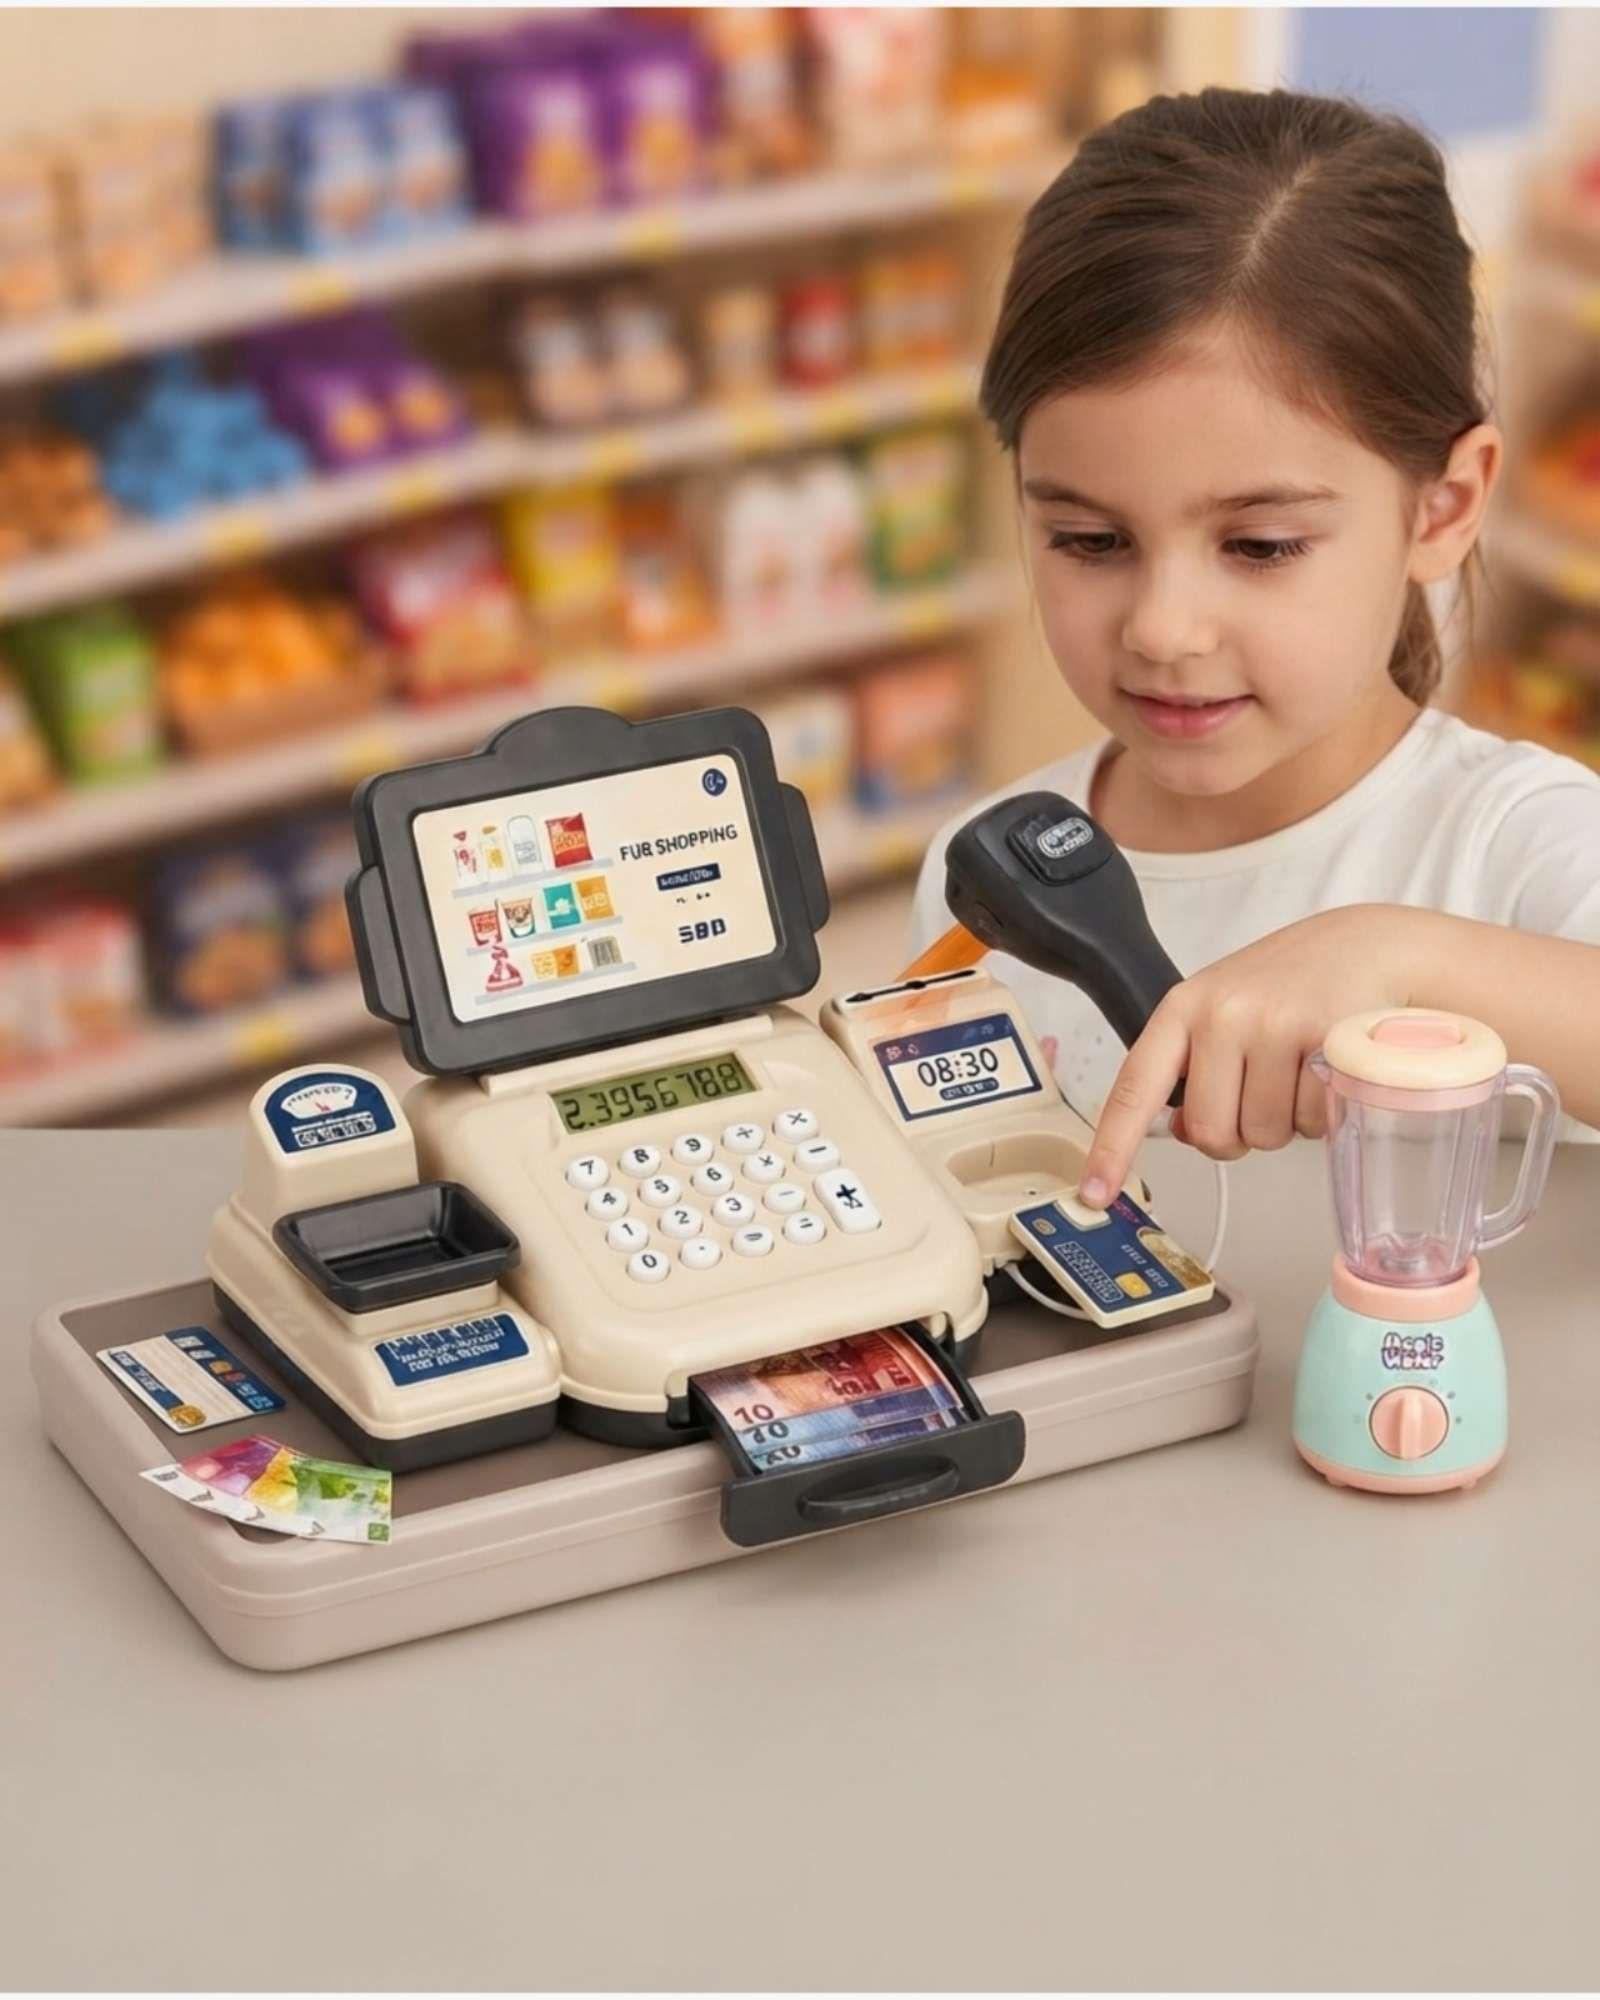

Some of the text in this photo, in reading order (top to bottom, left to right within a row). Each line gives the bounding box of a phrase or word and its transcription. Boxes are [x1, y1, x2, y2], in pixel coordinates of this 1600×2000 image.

[655, 824, 738, 855] SHOPPING
[917, 1048, 999, 1087] 08:30
[579, 1138, 701, 1175] 7 8 9
[654, 1179, 669, 1193] 5
[706, 1167, 722, 1182] 6
[622, 1197, 742, 1236] 1 2 3
[642, 1254, 657, 1268] 0
[734, 1404, 774, 1424] 10
